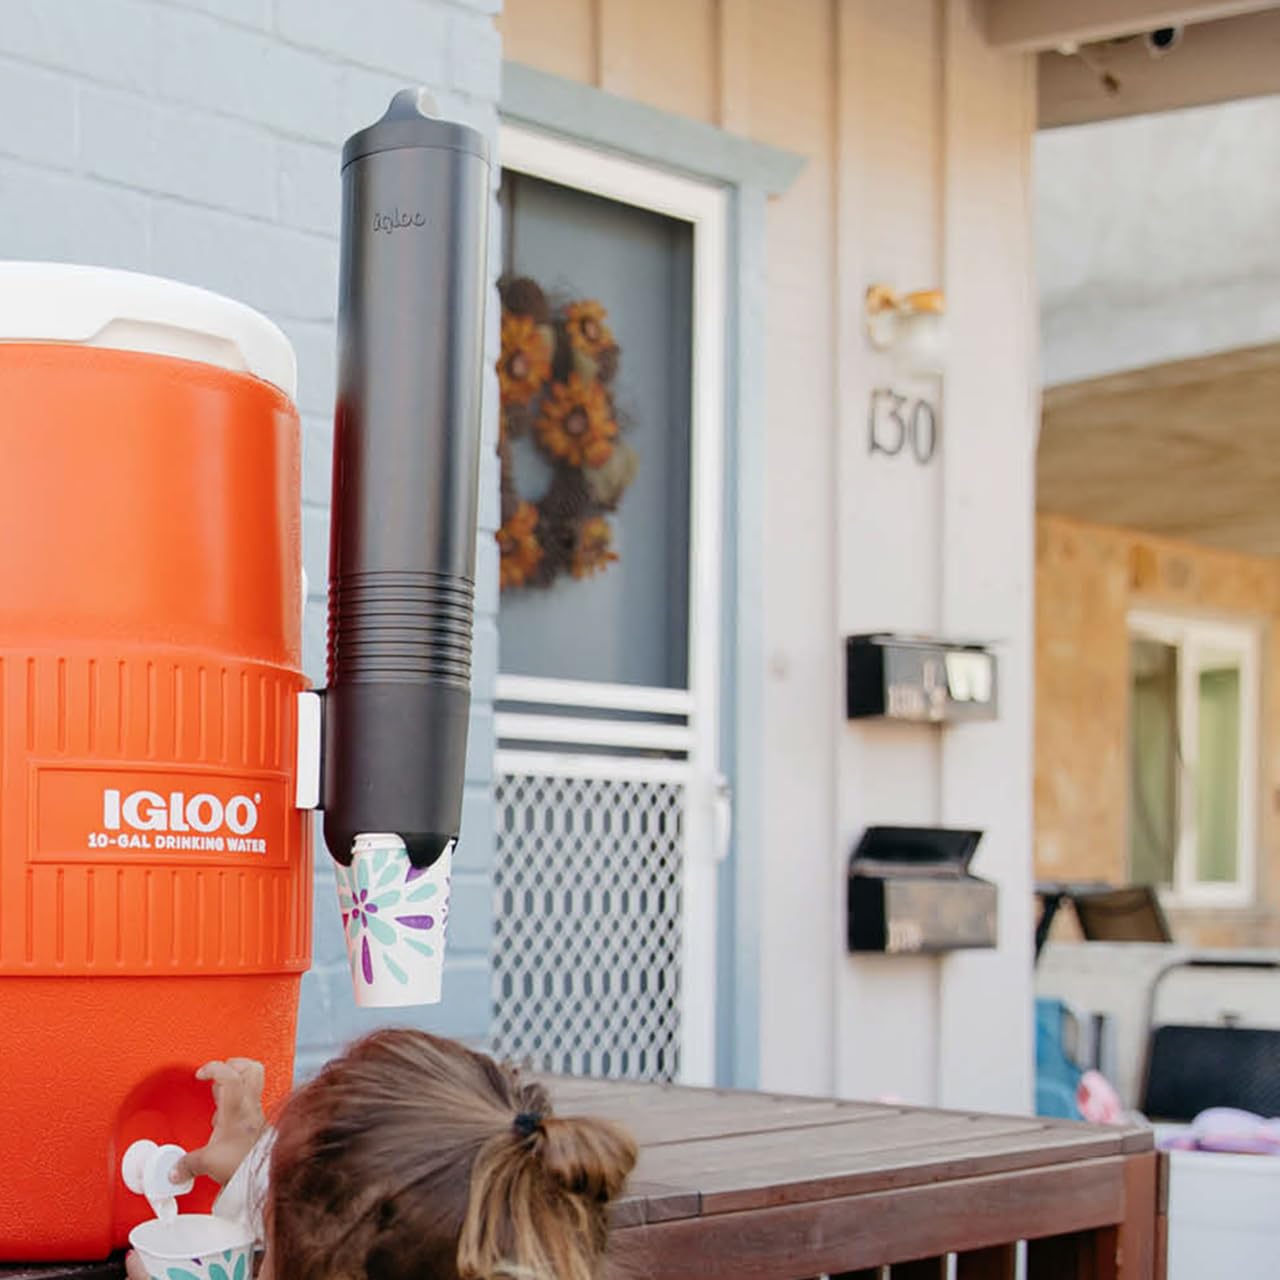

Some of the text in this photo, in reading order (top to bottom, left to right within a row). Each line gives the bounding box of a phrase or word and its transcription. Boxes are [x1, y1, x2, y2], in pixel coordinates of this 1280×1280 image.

[373, 206, 427, 234] igloo
[103, 789, 261, 835] IGLOO
[87, 832, 266, 854] 10-GAL DRINKING WATER
